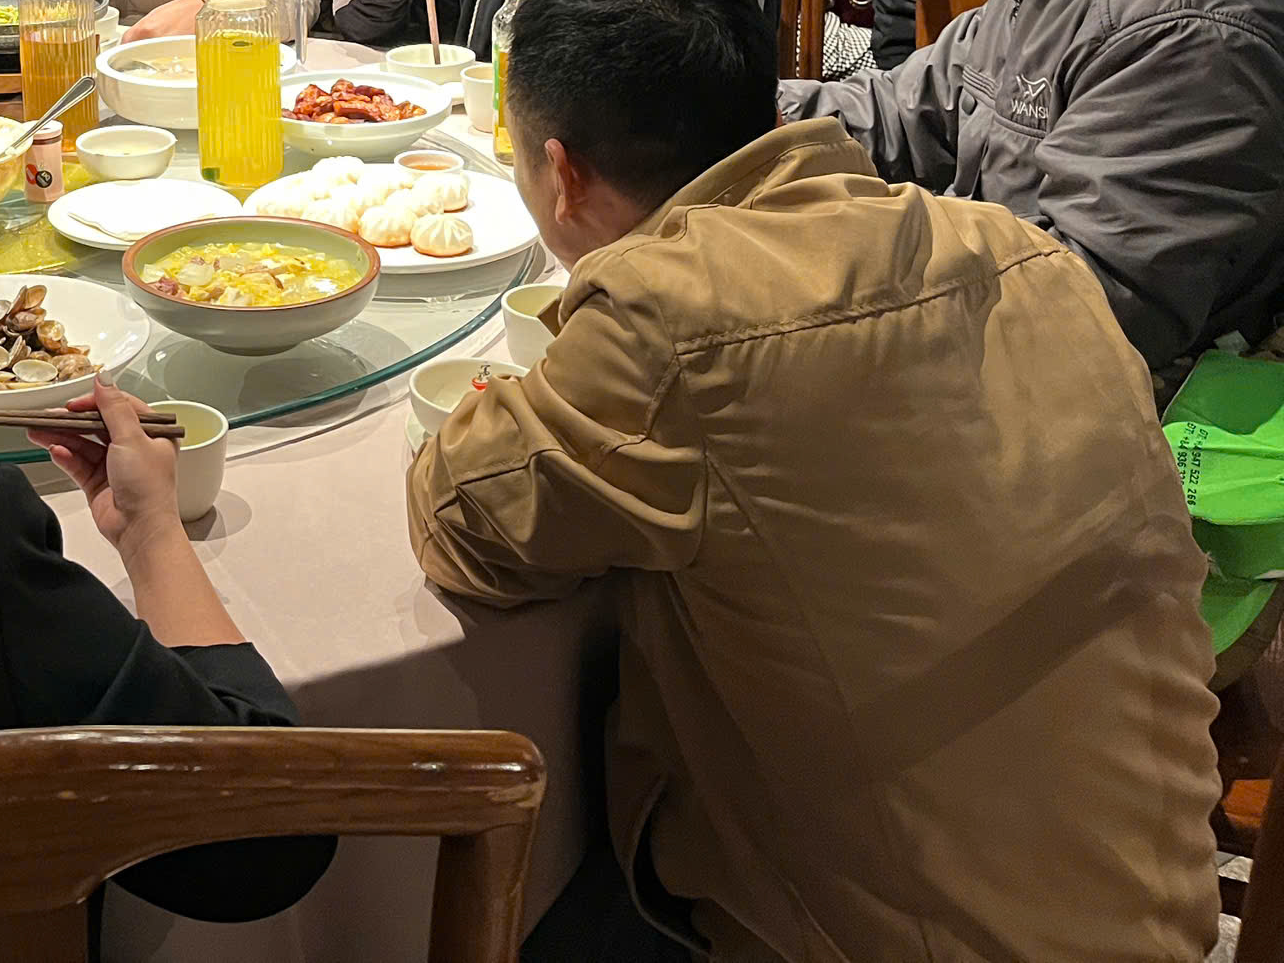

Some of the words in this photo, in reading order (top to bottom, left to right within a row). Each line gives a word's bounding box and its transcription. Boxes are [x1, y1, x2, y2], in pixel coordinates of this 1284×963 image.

[1177, 452, 1187, 467] 936
[1191, 451, 1202, 468] 947
[1190, 469, 1200, 485] 522
[1187, 488, 1196, 505] 266
